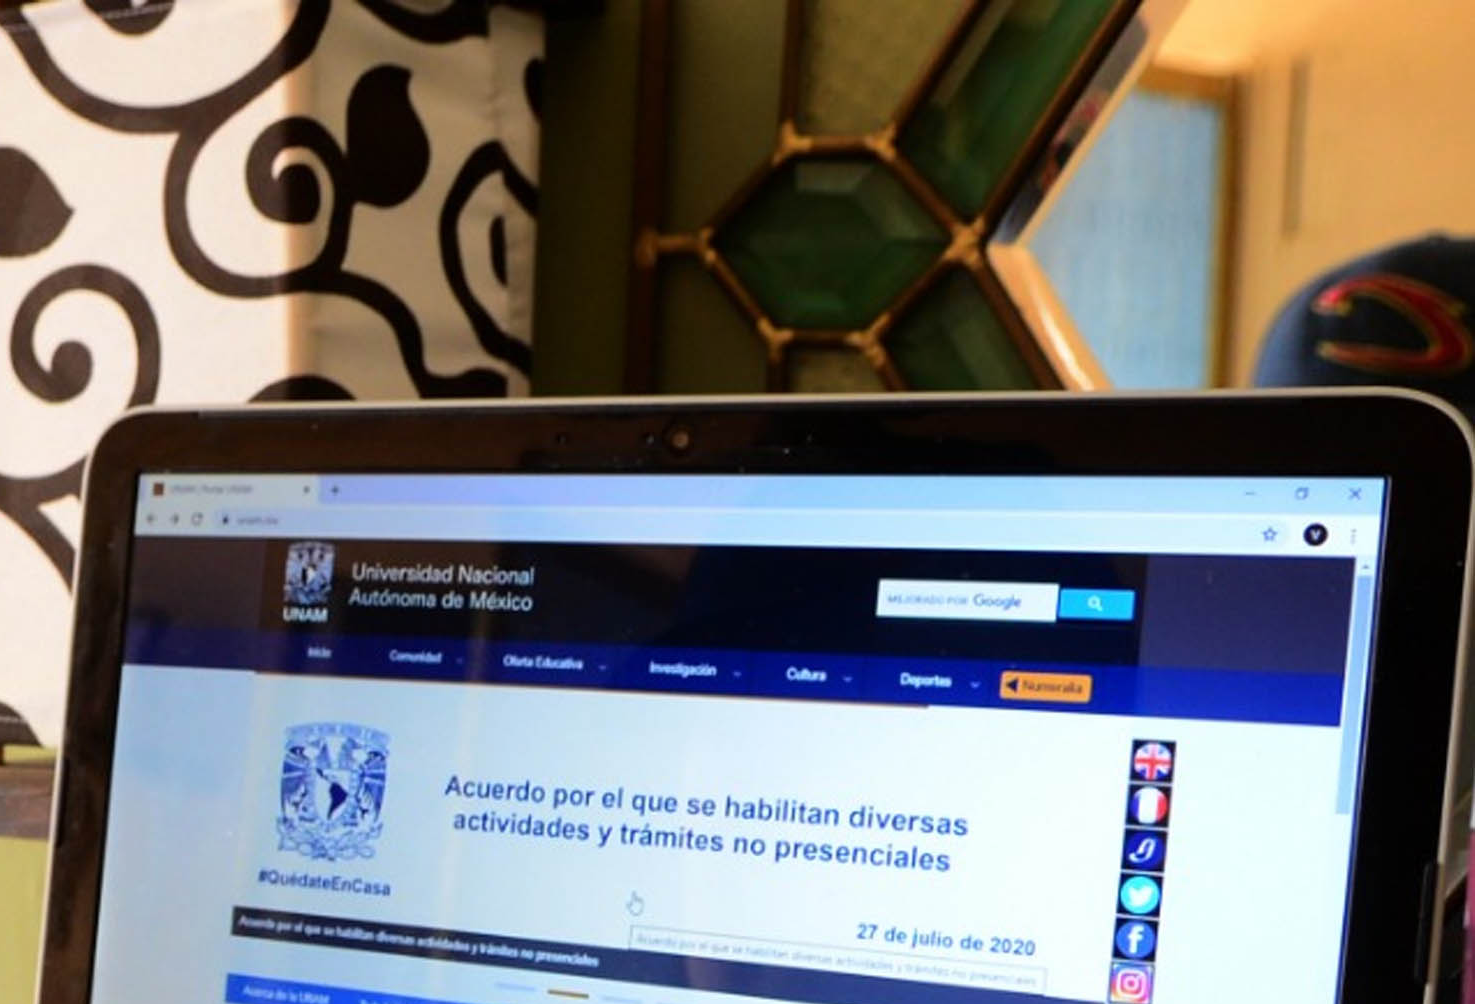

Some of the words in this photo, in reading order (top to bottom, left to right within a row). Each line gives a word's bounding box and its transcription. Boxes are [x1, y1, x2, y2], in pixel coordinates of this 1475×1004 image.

[352, 563, 453, 584] Universidad
[458, 564, 534, 586] Nacional
[348, 587, 436, 608] Autónoma
[441, 590, 463, 608] de
[470, 591, 533, 612] México
[973, 593, 1022, 611] Google
[283, 606, 328, 623] UNAM
[389, 649, 442, 663] Comunidad
[536, 655, 584, 670] Educativa
[649, 660, 717, 678] Investigación
[786, 666, 827, 682] Cultura
[899, 672, 953, 689] Deportes
[444, 775, 545, 804] Acuerdo
[553, 787, 595, 810] por
[601, 787, 623, 809] el
[632, 793, 677, 816] que
[687, 797, 716, 817] se
[725, 796, 839, 827] habilitan
[849, 806, 968, 836] diversas
[453, 812, 589, 841] actividades
[598, 826, 613, 848] y
[621, 823, 724, 852] trámites
[733, 837, 766, 856] no
[775, 840, 951, 872] presenciales
[258, 869, 391, 896] #QuédateEnCasa
[857, 923, 878, 940] 27
[884, 926, 907, 944] de
[912, 928, 954, 949] julio
[960, 935, 984, 950] de
[990, 936, 1037, 957] 2020
